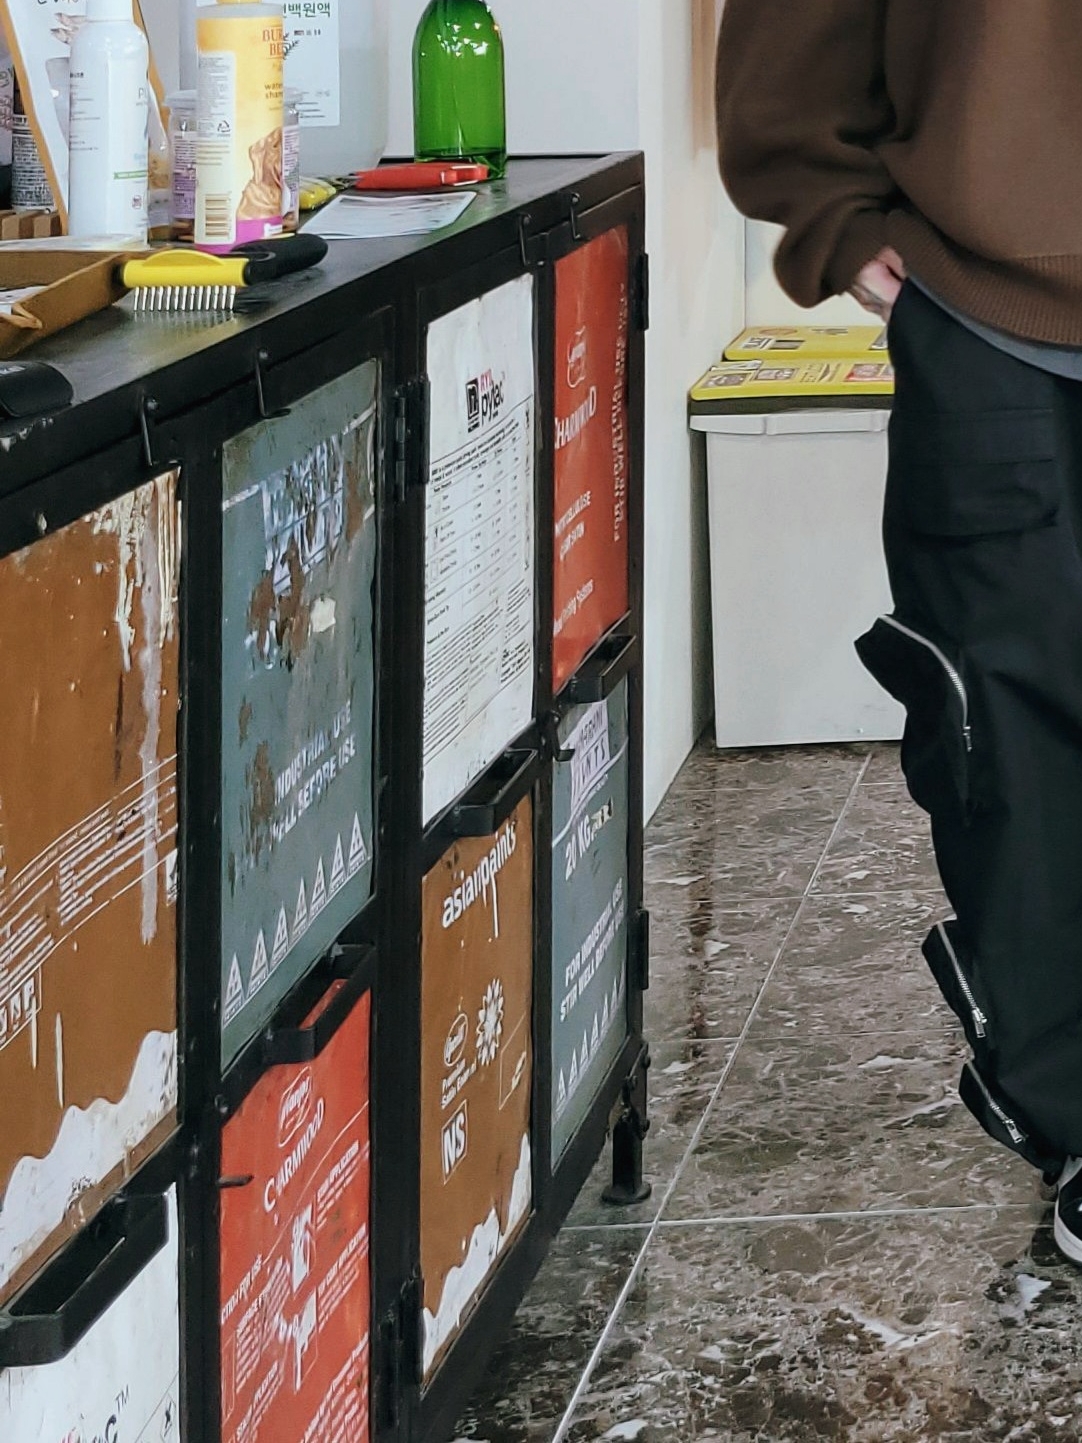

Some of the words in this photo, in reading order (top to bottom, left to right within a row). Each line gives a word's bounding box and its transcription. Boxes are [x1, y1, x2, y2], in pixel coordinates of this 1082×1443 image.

[274, 729, 331, 808] INDUSTRIA
[442, 822, 516, 928] asianpaints
[566, 951, 581, 988] FOR
[443, 1111, 465, 1175] NS
